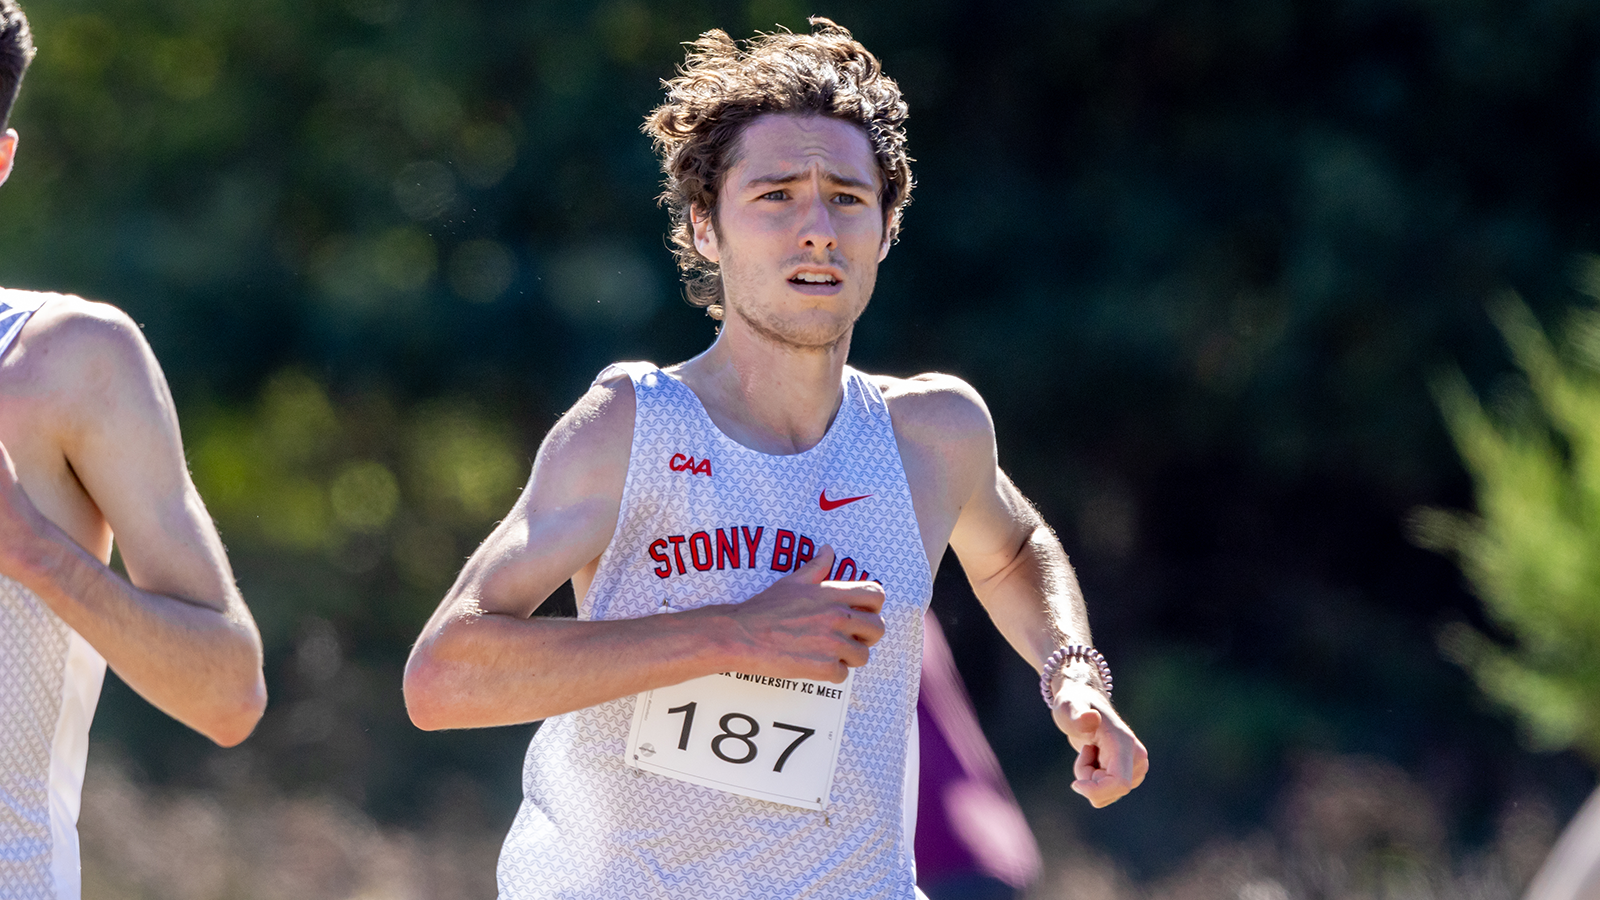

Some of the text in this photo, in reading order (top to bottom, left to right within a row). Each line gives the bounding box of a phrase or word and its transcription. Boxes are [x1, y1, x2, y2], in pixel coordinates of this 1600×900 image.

[669, 453, 712, 476] CAA
[648, 526, 883, 582] STONY BRO
[735, 672, 843, 700] UNIVERSITY XC MEET
[667, 701, 816, 773] 187
